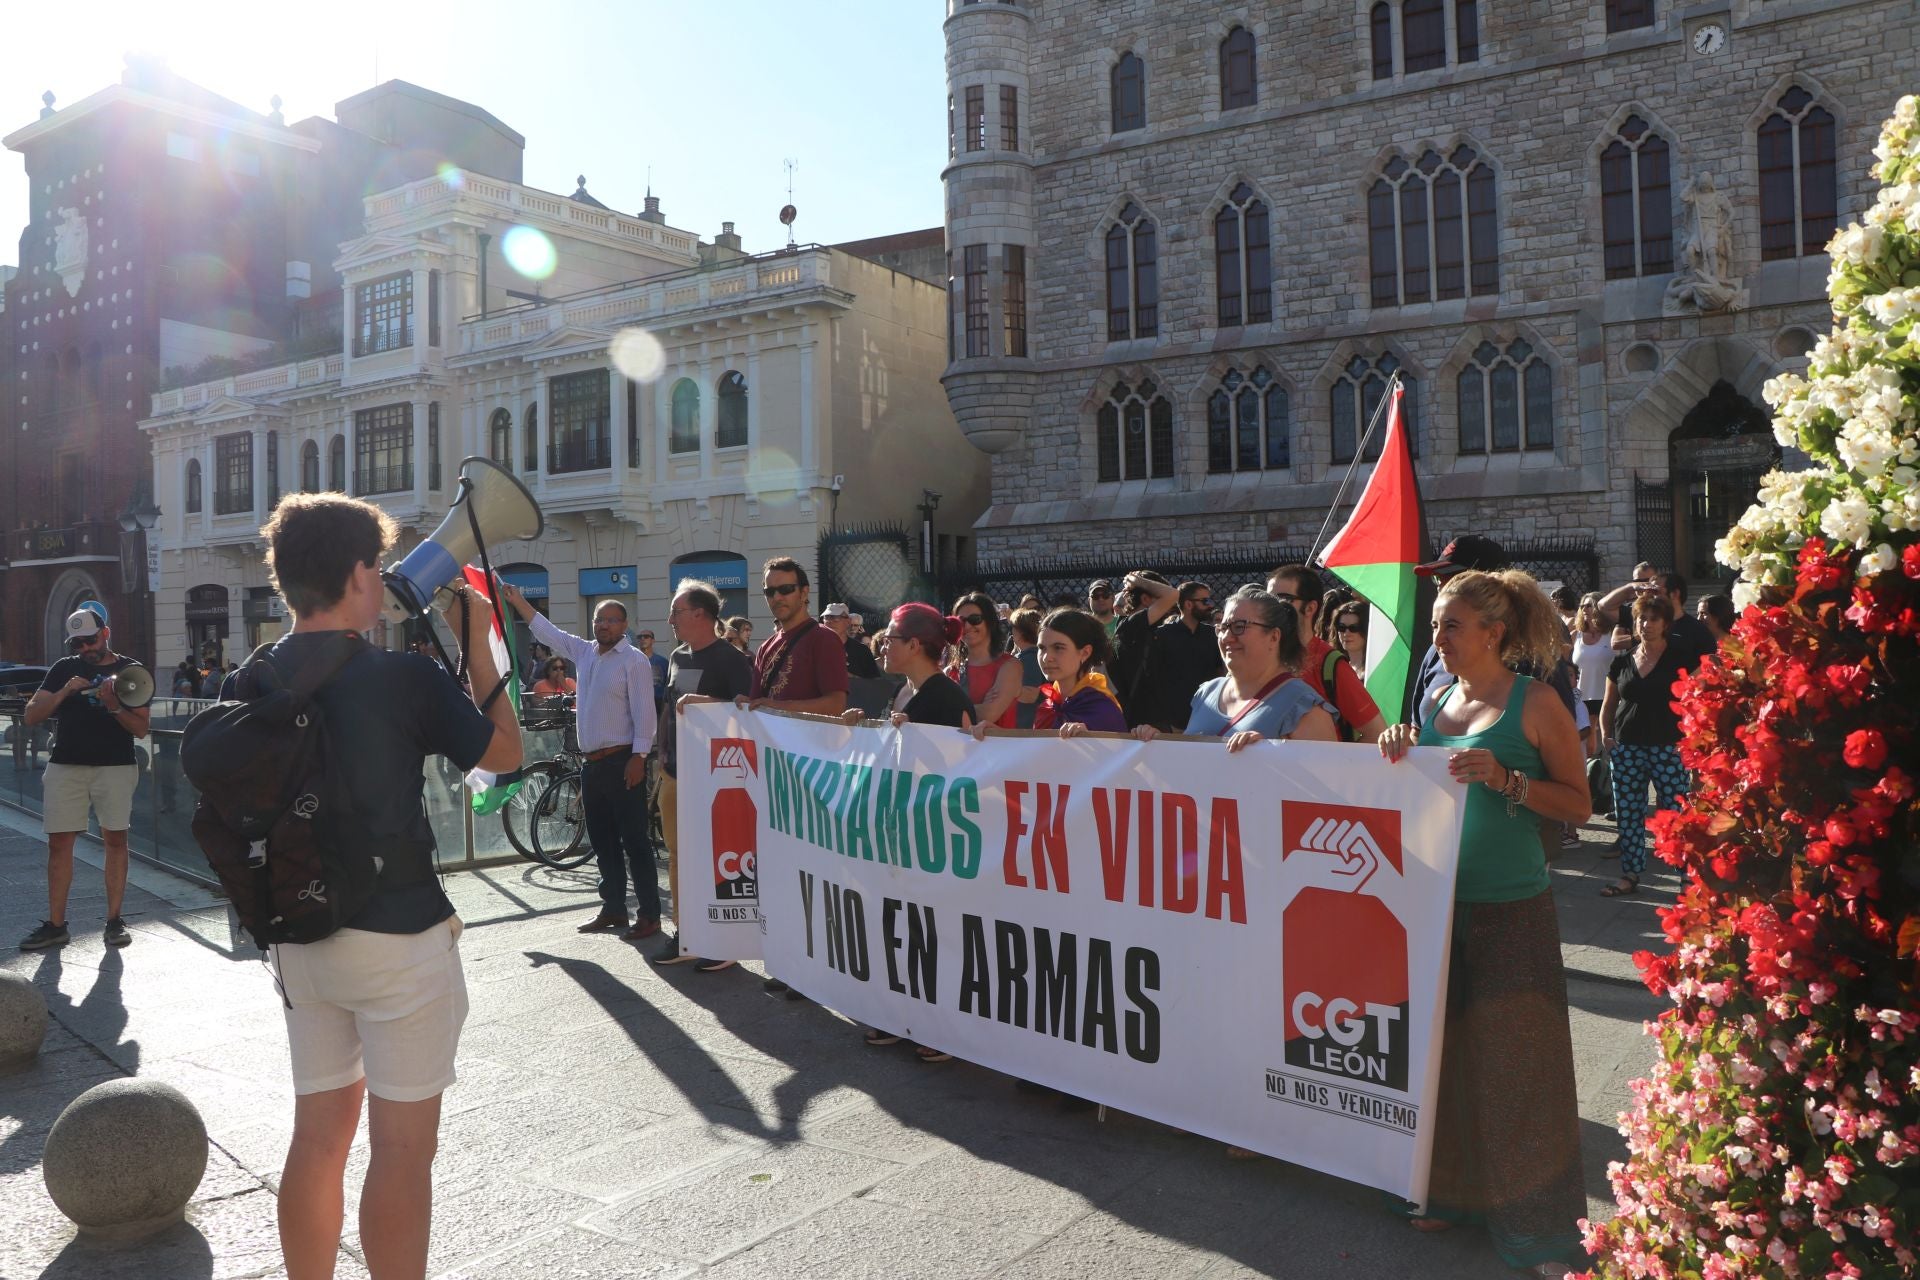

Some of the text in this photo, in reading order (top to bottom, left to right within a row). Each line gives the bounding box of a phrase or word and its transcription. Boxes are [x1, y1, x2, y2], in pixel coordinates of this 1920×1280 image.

[764, 747, 1248, 925] INVIRTAMOS EN VIDA
[718, 851, 756, 880] CG
[731, 883, 757, 897] LE
[723, 907, 747, 920] NOS
[799, 870, 1161, 1064] Y NO EN ARMAS
[1292, 991, 1401, 1055] CGT
[1309, 1043, 1387, 1081] LEÓN
[1265, 1073, 1286, 1096] NO
[1294, 1081, 1329, 1106] NOS
